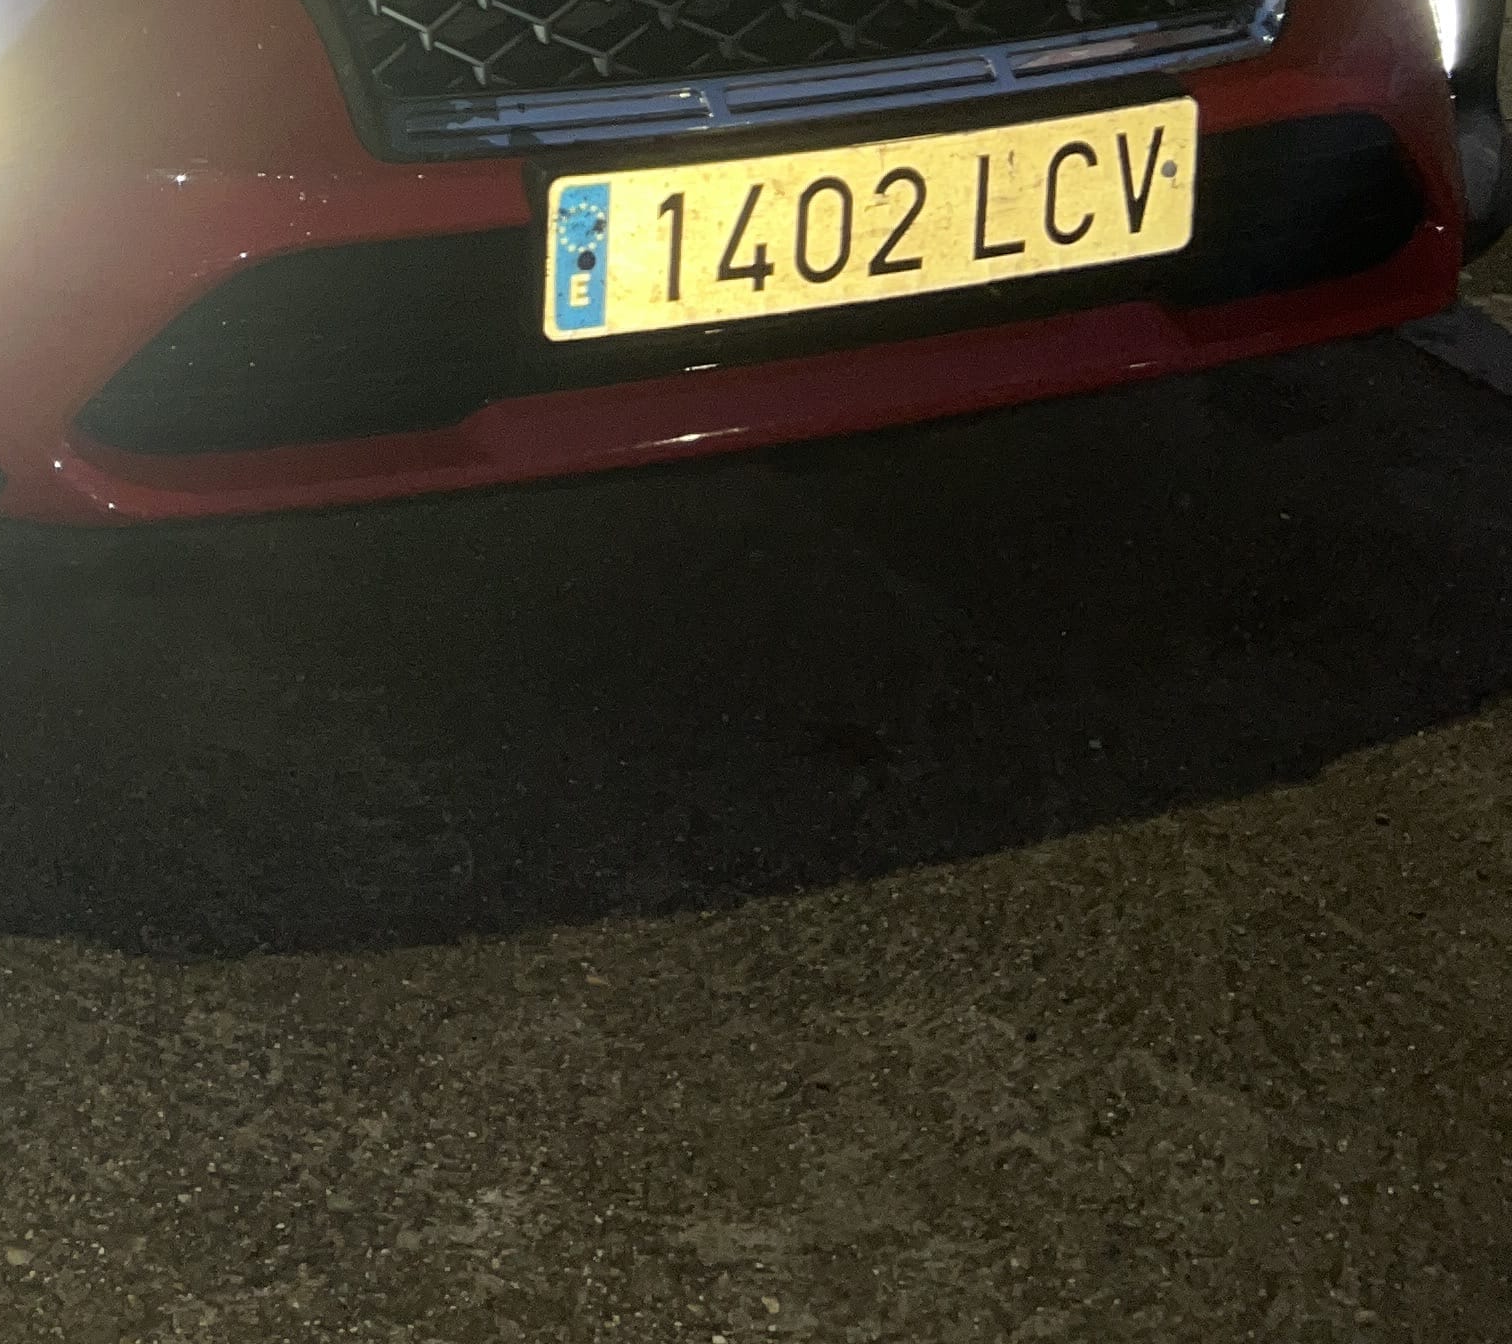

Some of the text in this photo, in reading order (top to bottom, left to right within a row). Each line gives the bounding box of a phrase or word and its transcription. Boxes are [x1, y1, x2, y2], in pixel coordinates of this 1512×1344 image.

[657, 125, 1166, 302] 1402 LCV
[569, 272, 590, 307] E
